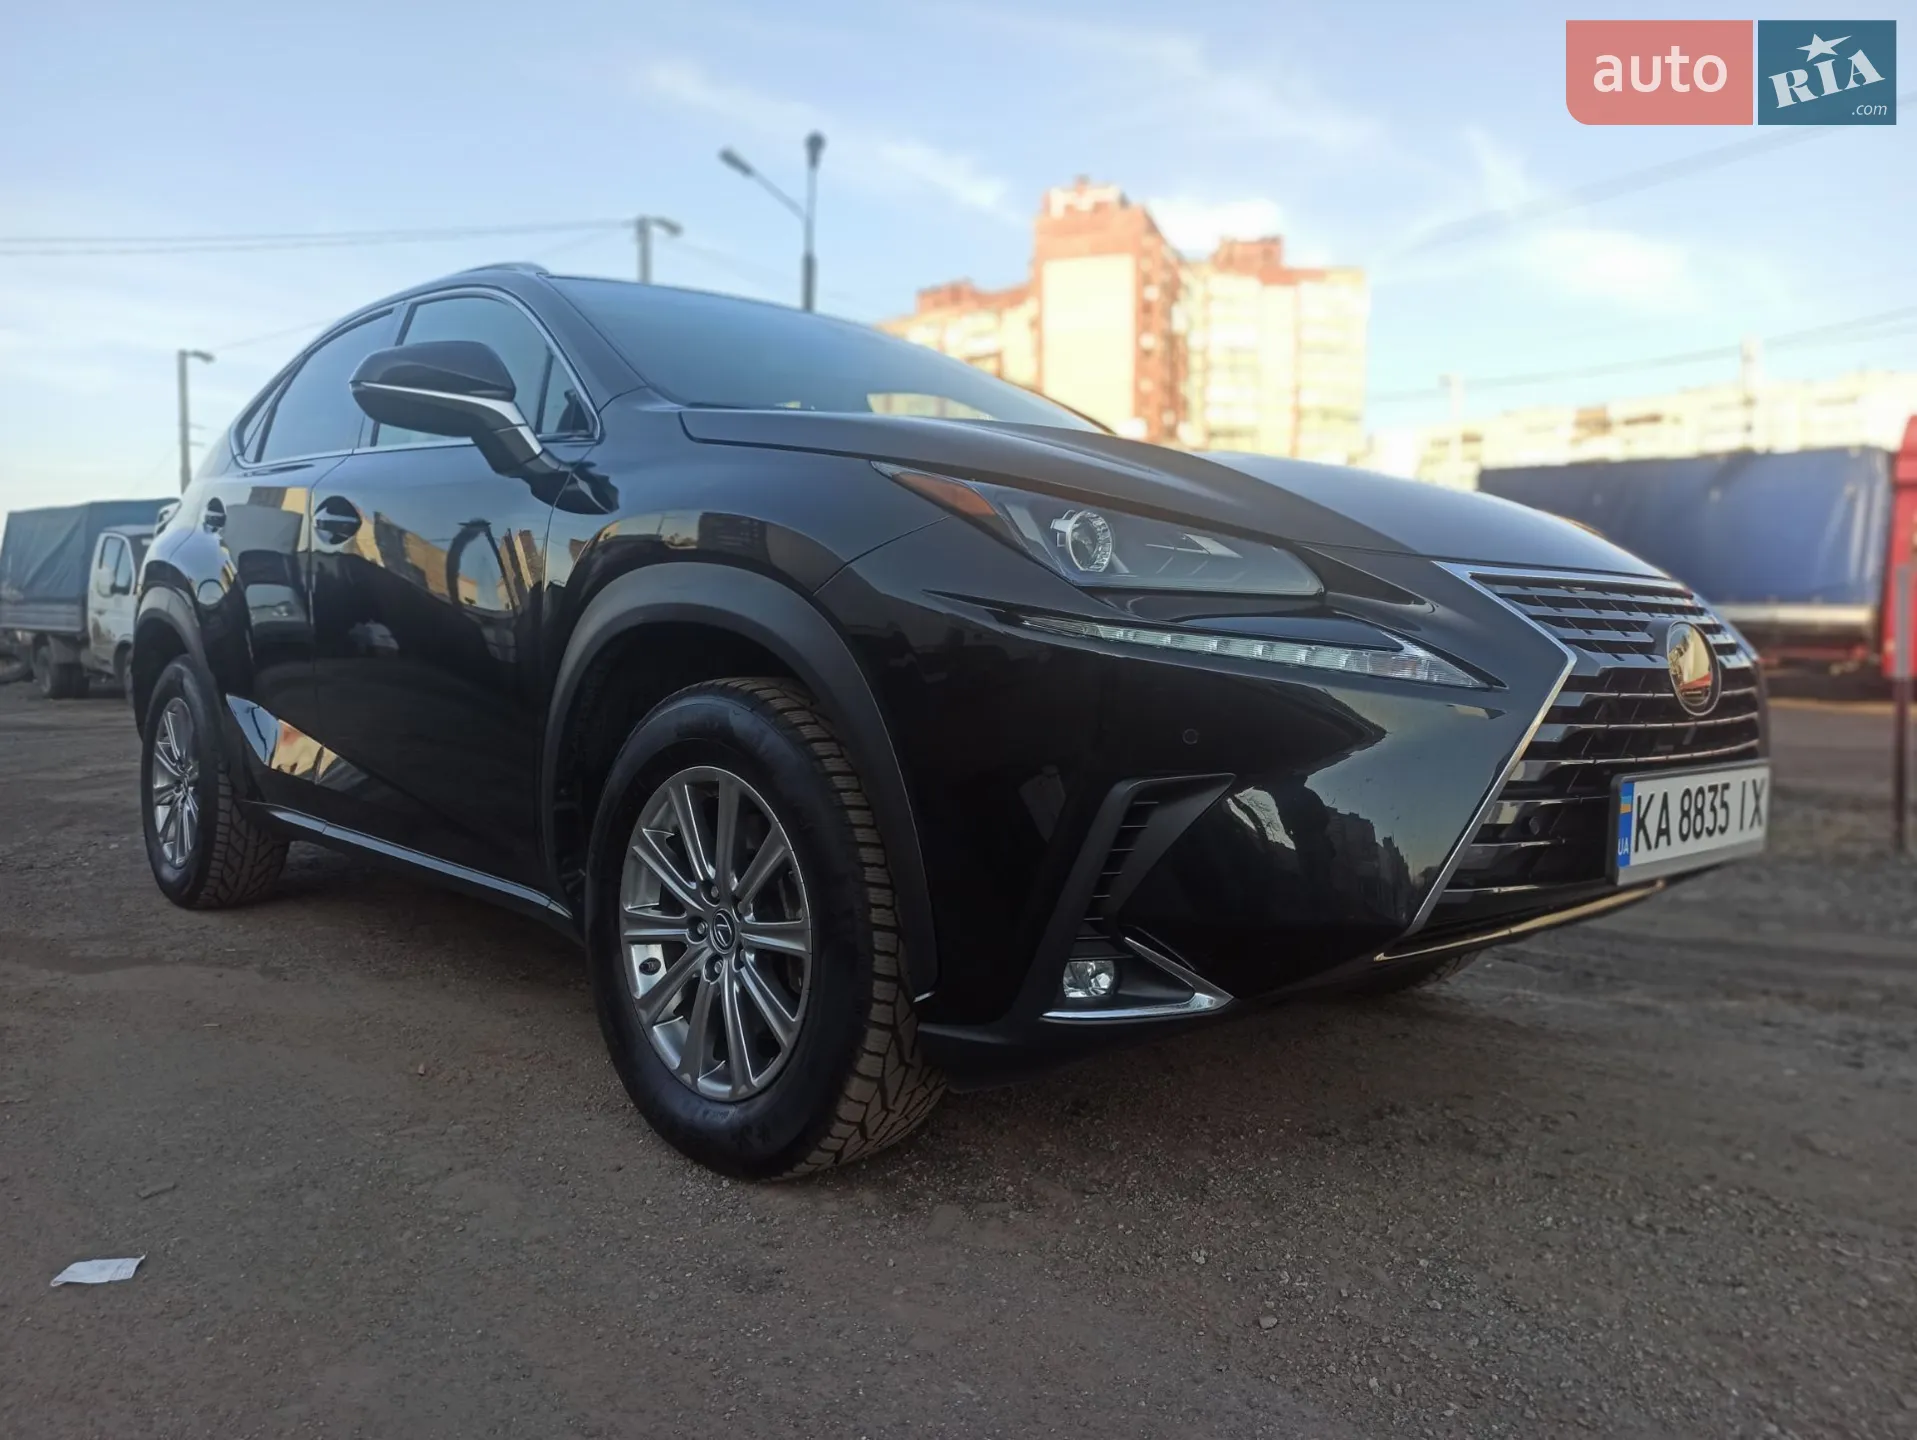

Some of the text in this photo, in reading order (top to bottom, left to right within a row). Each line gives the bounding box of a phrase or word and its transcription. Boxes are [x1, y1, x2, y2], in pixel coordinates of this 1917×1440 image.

[1634, 777, 1766, 853] KA 8835 IX
[1617, 838, 1629, 855] UA
